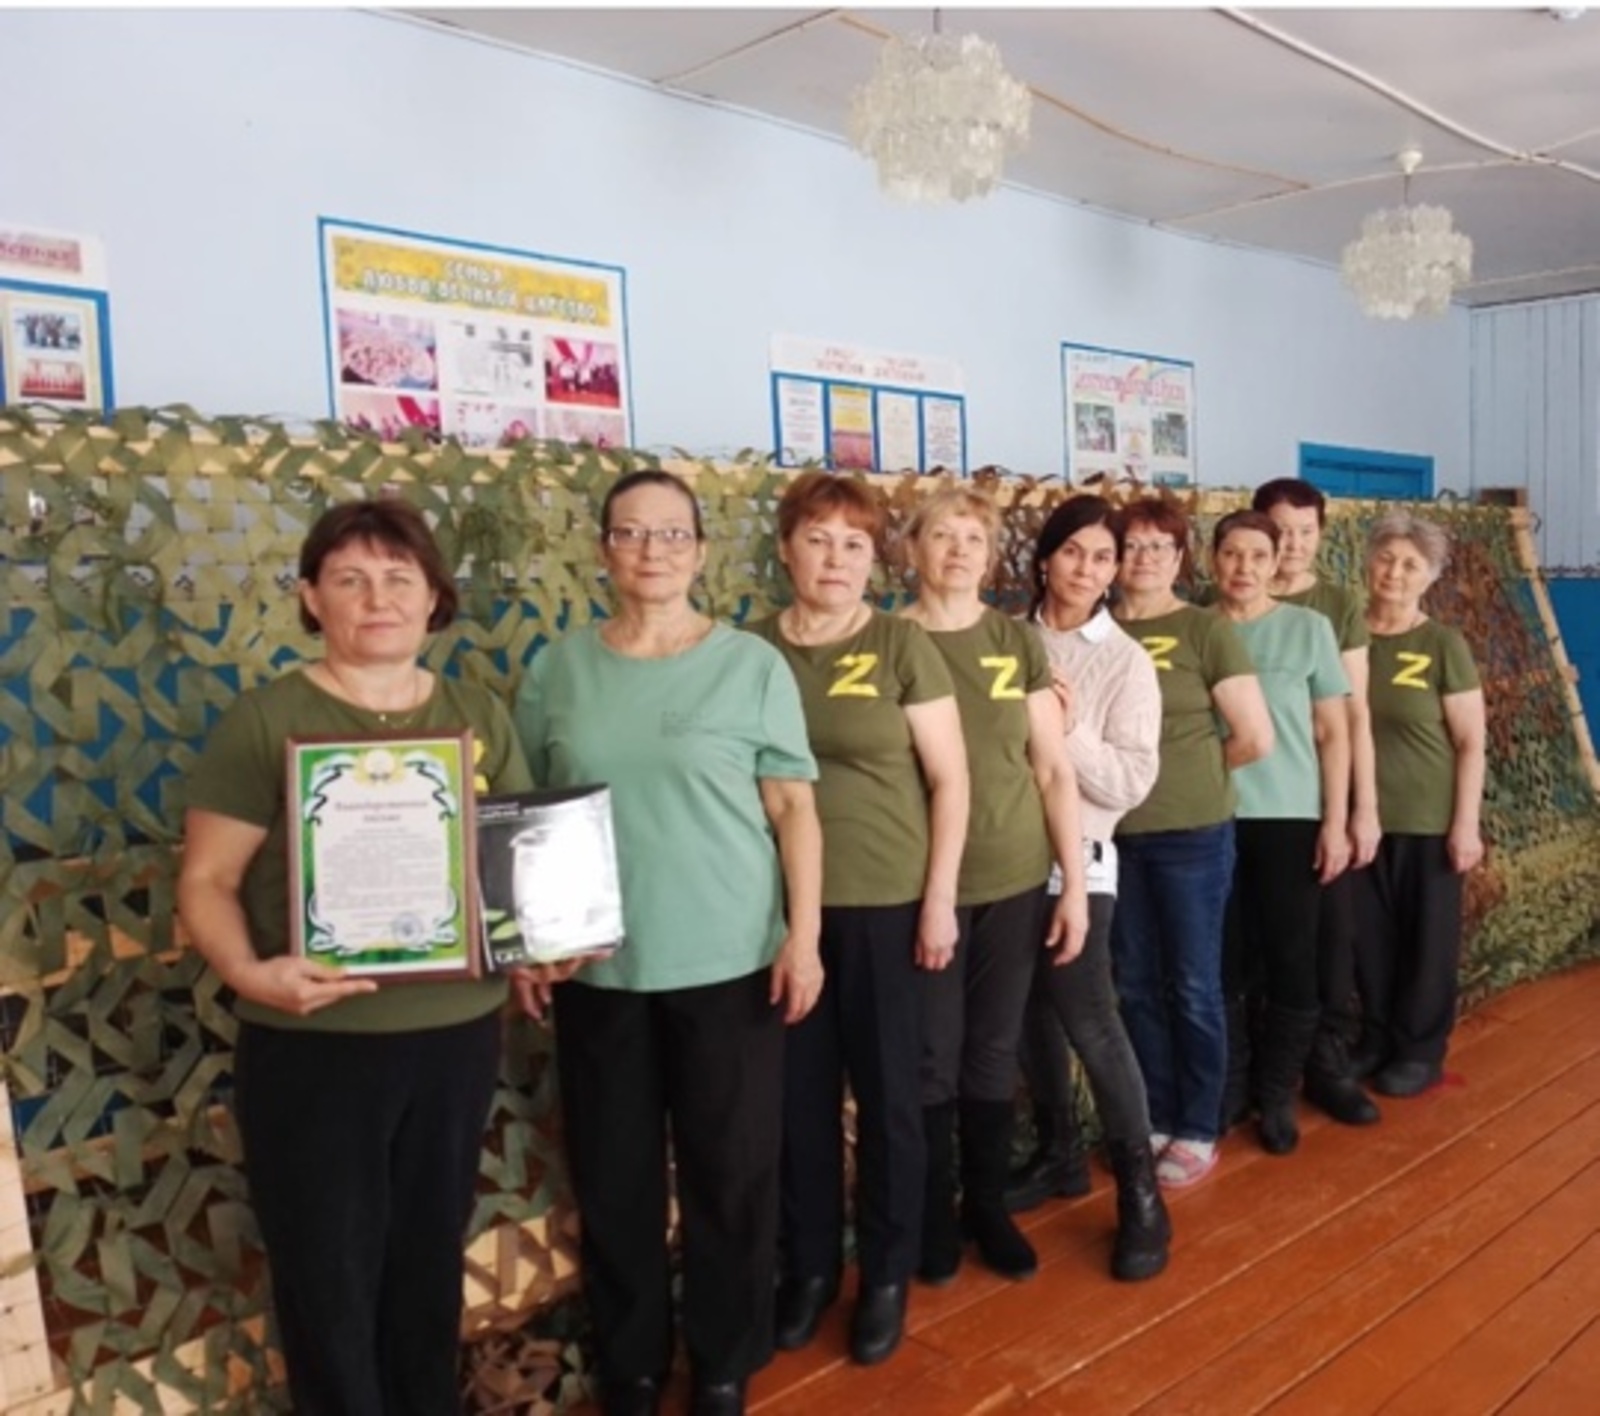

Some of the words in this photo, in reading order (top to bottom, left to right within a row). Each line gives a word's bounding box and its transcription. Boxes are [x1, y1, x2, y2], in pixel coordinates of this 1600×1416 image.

[827, 653, 880, 698] Z
[979, 655, 1026, 699] Z
[1391, 651, 1433, 690] Z
